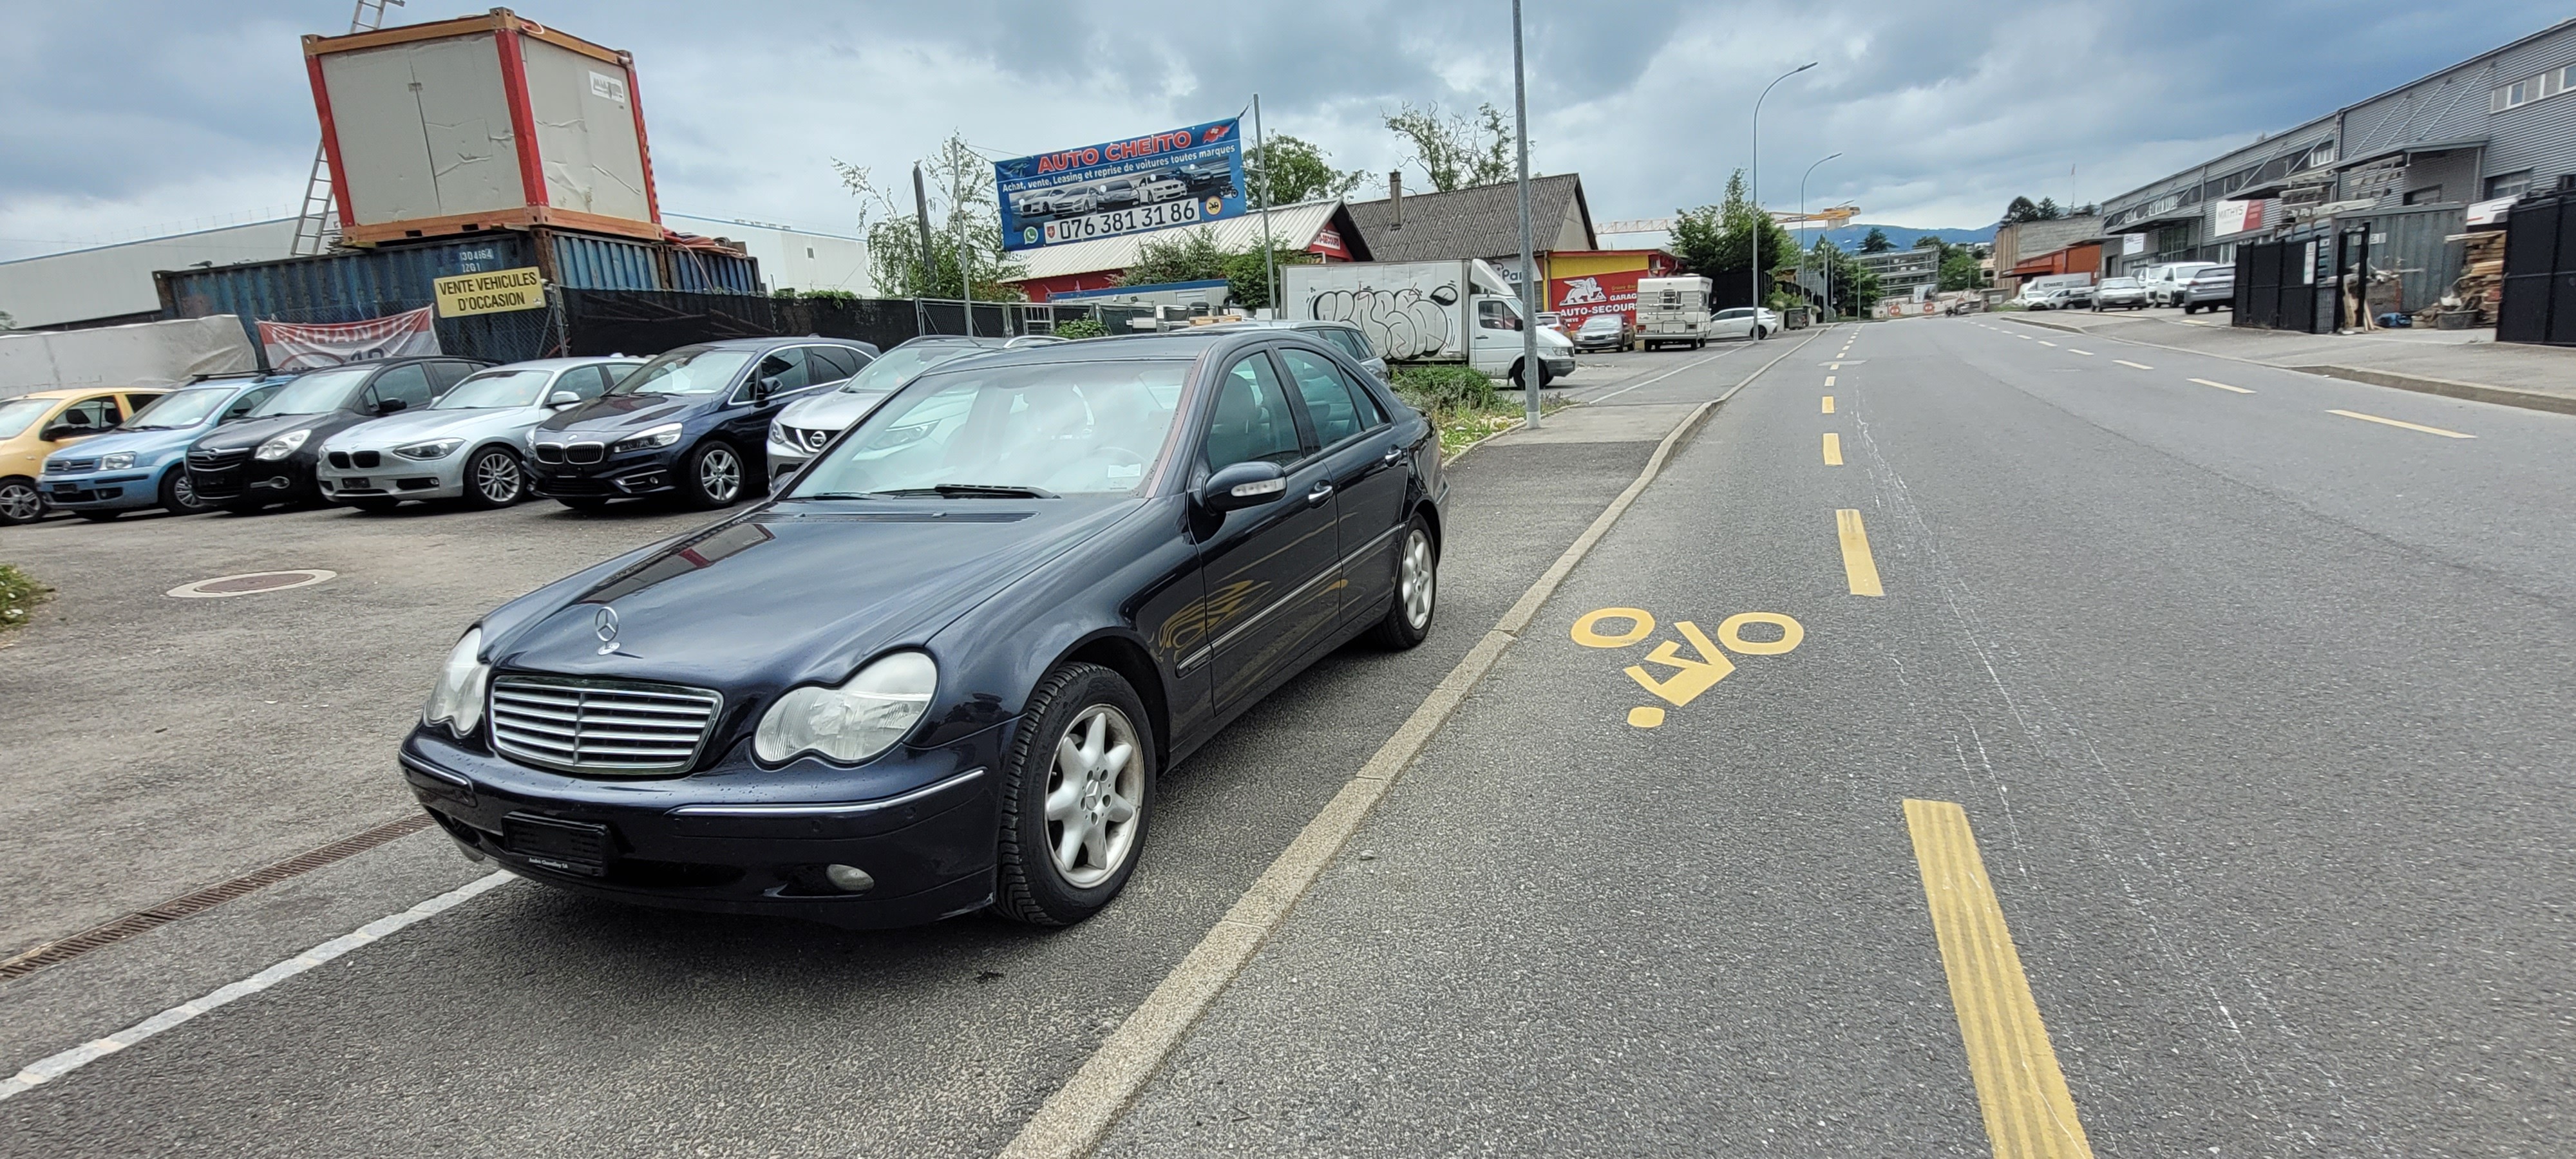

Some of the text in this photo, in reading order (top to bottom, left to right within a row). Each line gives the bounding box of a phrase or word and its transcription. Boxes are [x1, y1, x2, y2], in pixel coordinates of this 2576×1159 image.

[1037, 131, 1191, 174] AUTO CHEITO
[1003, 145, 1235, 193] Achat, vente, Leasing et reprise de voitures toutes marques
[1060, 201, 1195, 239] 076 381 31 86
[439, 272, 537, 295] VENTE VEHICULES
[1610, 293, 1637, 301] GARAG
[458, 292, 525, 311] D'OCCASION
